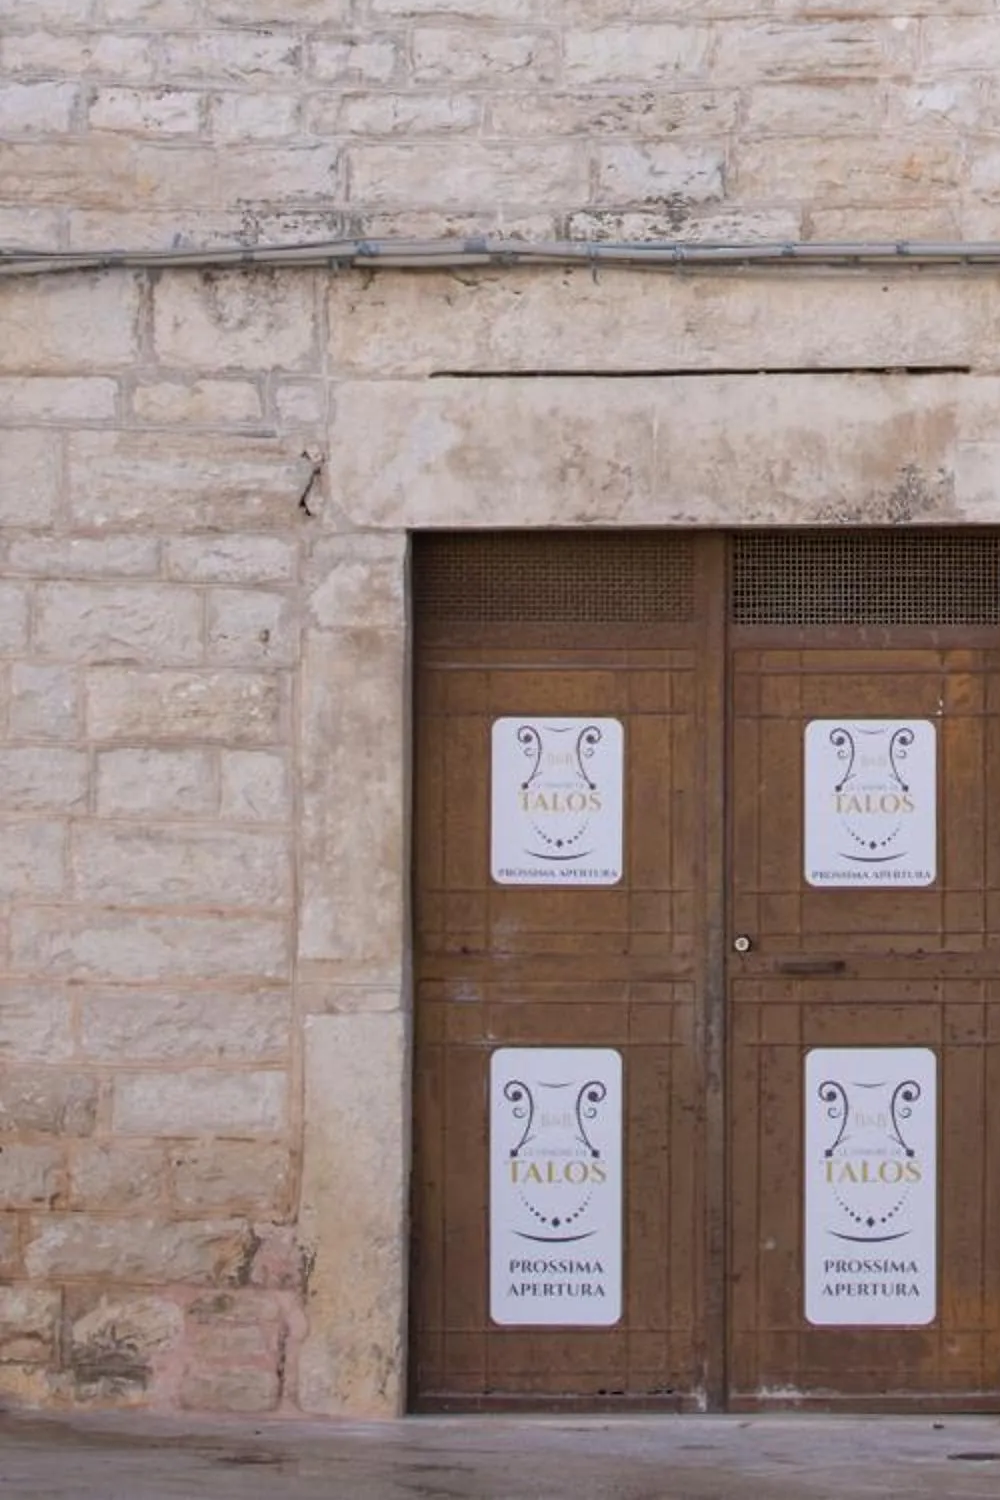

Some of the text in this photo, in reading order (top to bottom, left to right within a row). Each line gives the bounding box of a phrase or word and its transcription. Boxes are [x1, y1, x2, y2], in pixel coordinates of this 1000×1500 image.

[518, 790, 603, 813] TALOS
[831, 792, 915, 815] TALOS
[505, 1159, 607, 1185] TALOS
[820, 1159, 922, 1185] TALOS
[508, 1258, 605, 1275] PROSSIMA
[823, 1258, 919, 1275] PROSSIMA
[506, 1282, 606, 1298] APERTURA
[821, 1282, 921, 1298] APERTURA
